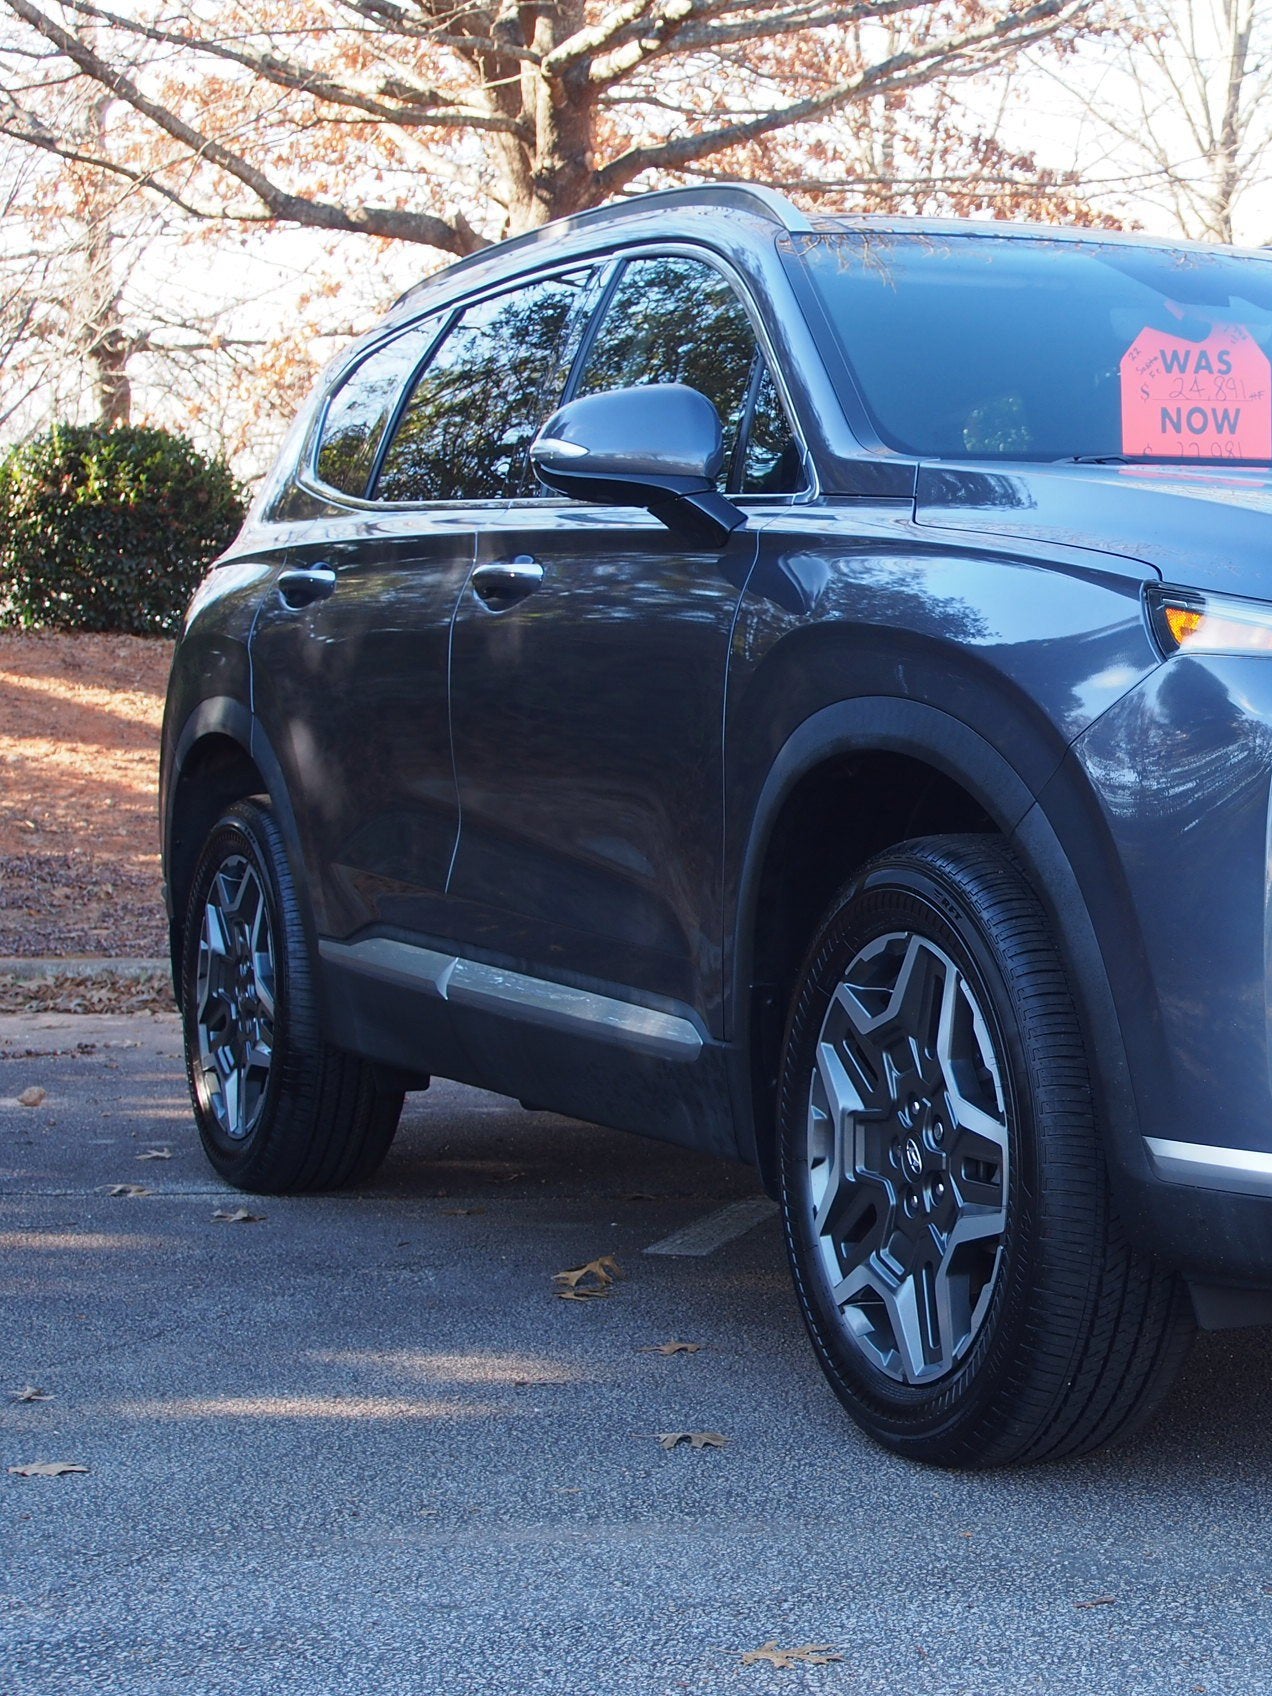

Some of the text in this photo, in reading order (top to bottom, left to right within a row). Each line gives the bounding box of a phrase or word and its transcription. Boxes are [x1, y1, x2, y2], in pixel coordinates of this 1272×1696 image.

[1160, 349, 1232, 375] WAS
[1140, 382, 1150, 402] $
[1161, 406, 1241, 435] NOW
